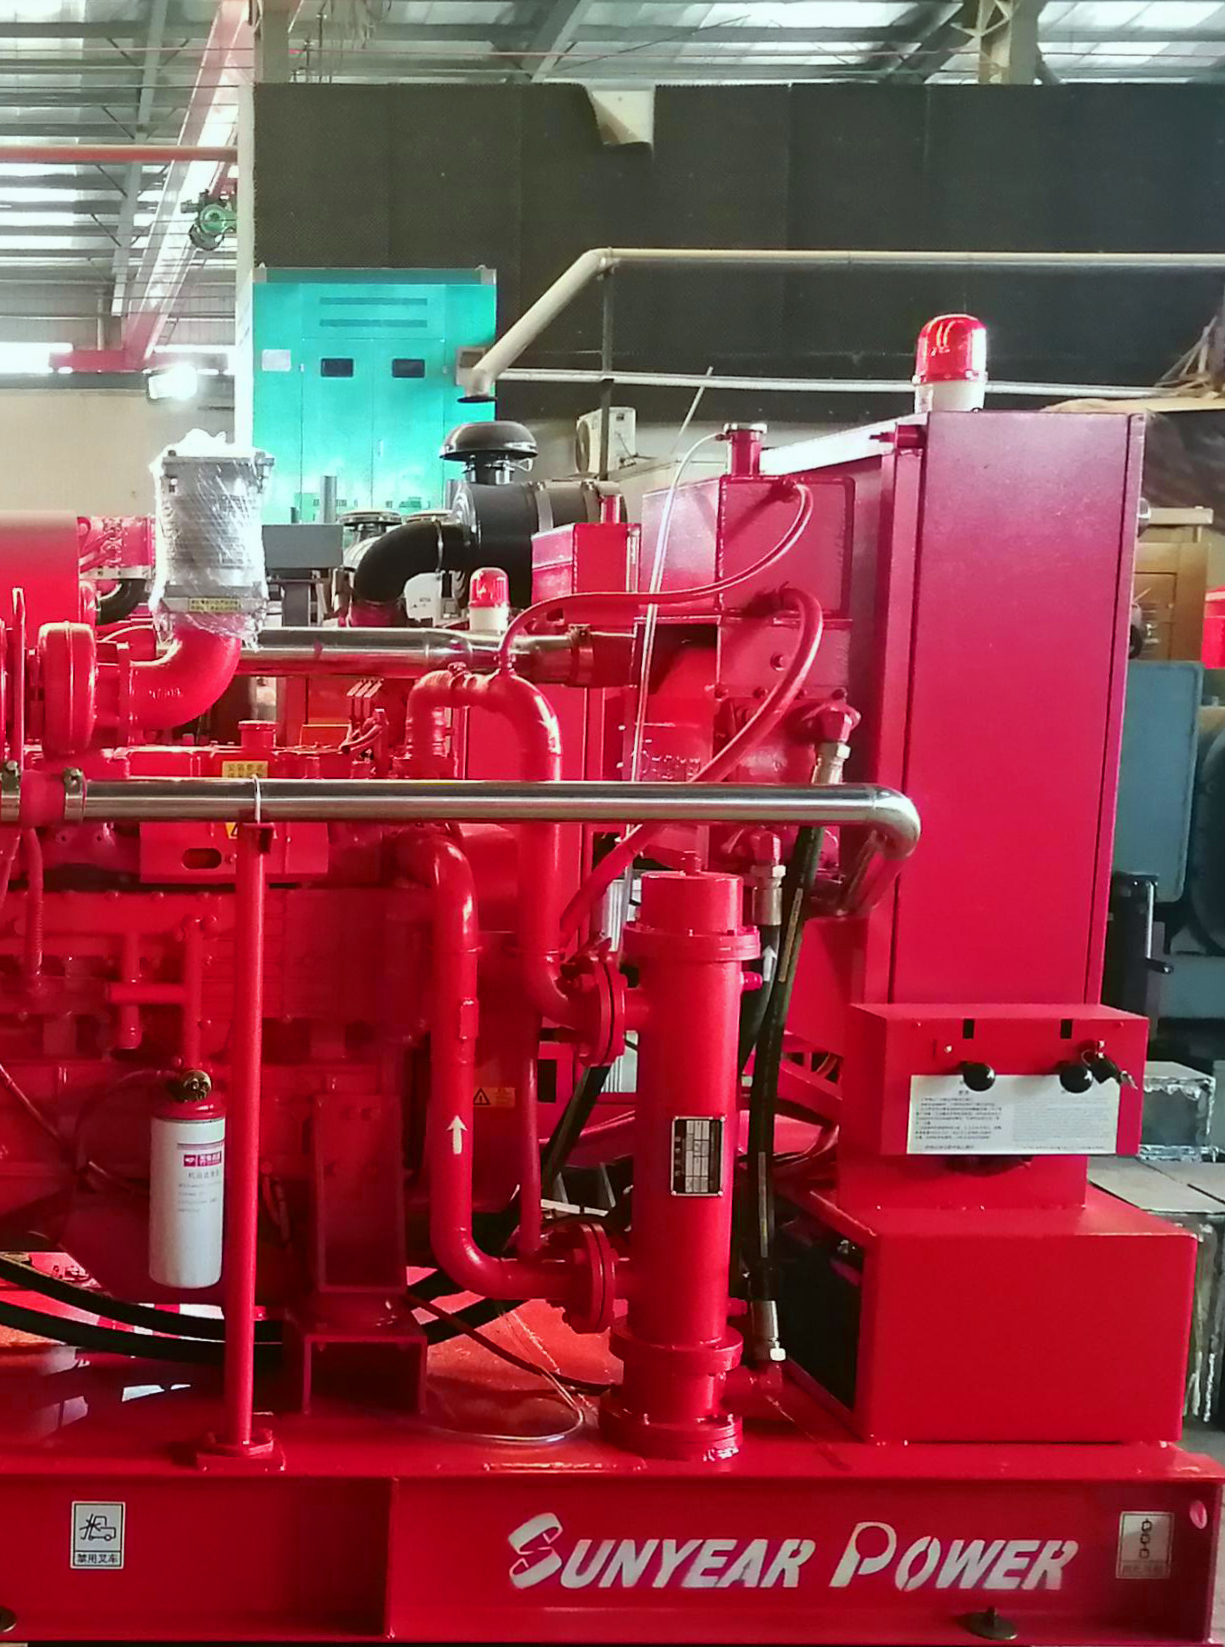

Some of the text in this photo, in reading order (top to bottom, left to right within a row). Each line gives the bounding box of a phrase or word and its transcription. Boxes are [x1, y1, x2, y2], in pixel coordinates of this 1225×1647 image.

[77, 1553, 118, 1563] 禁用叉车
[508, 1512, 1079, 1591] SUNYEAR POWER
